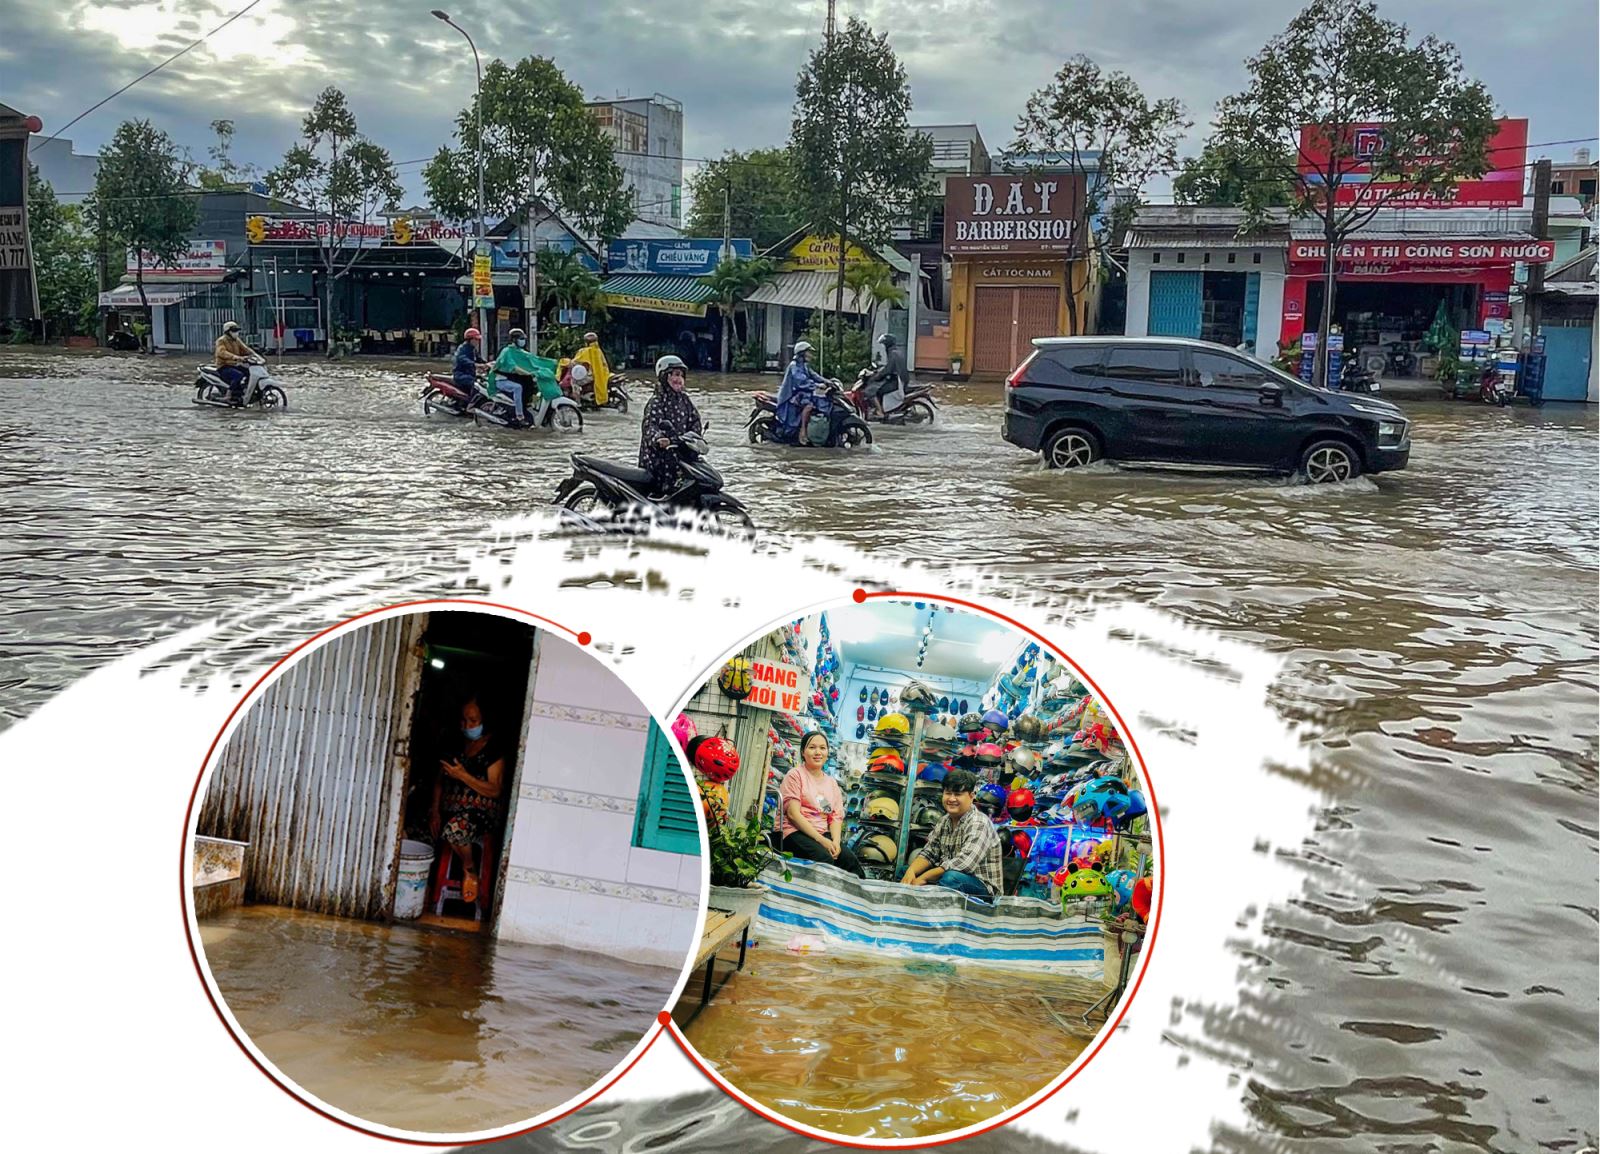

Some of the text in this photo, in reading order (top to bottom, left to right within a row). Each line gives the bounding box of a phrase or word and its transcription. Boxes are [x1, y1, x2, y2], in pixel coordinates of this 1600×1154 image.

[972, 181, 1058, 215] D.A.T
[956, 219, 1077, 241] BARBERSHOP
[1297, 243, 1550, 258] CHÊN THI CÔNG SƠN NƯỚC
[1027, 268, 1052, 277] NAM
